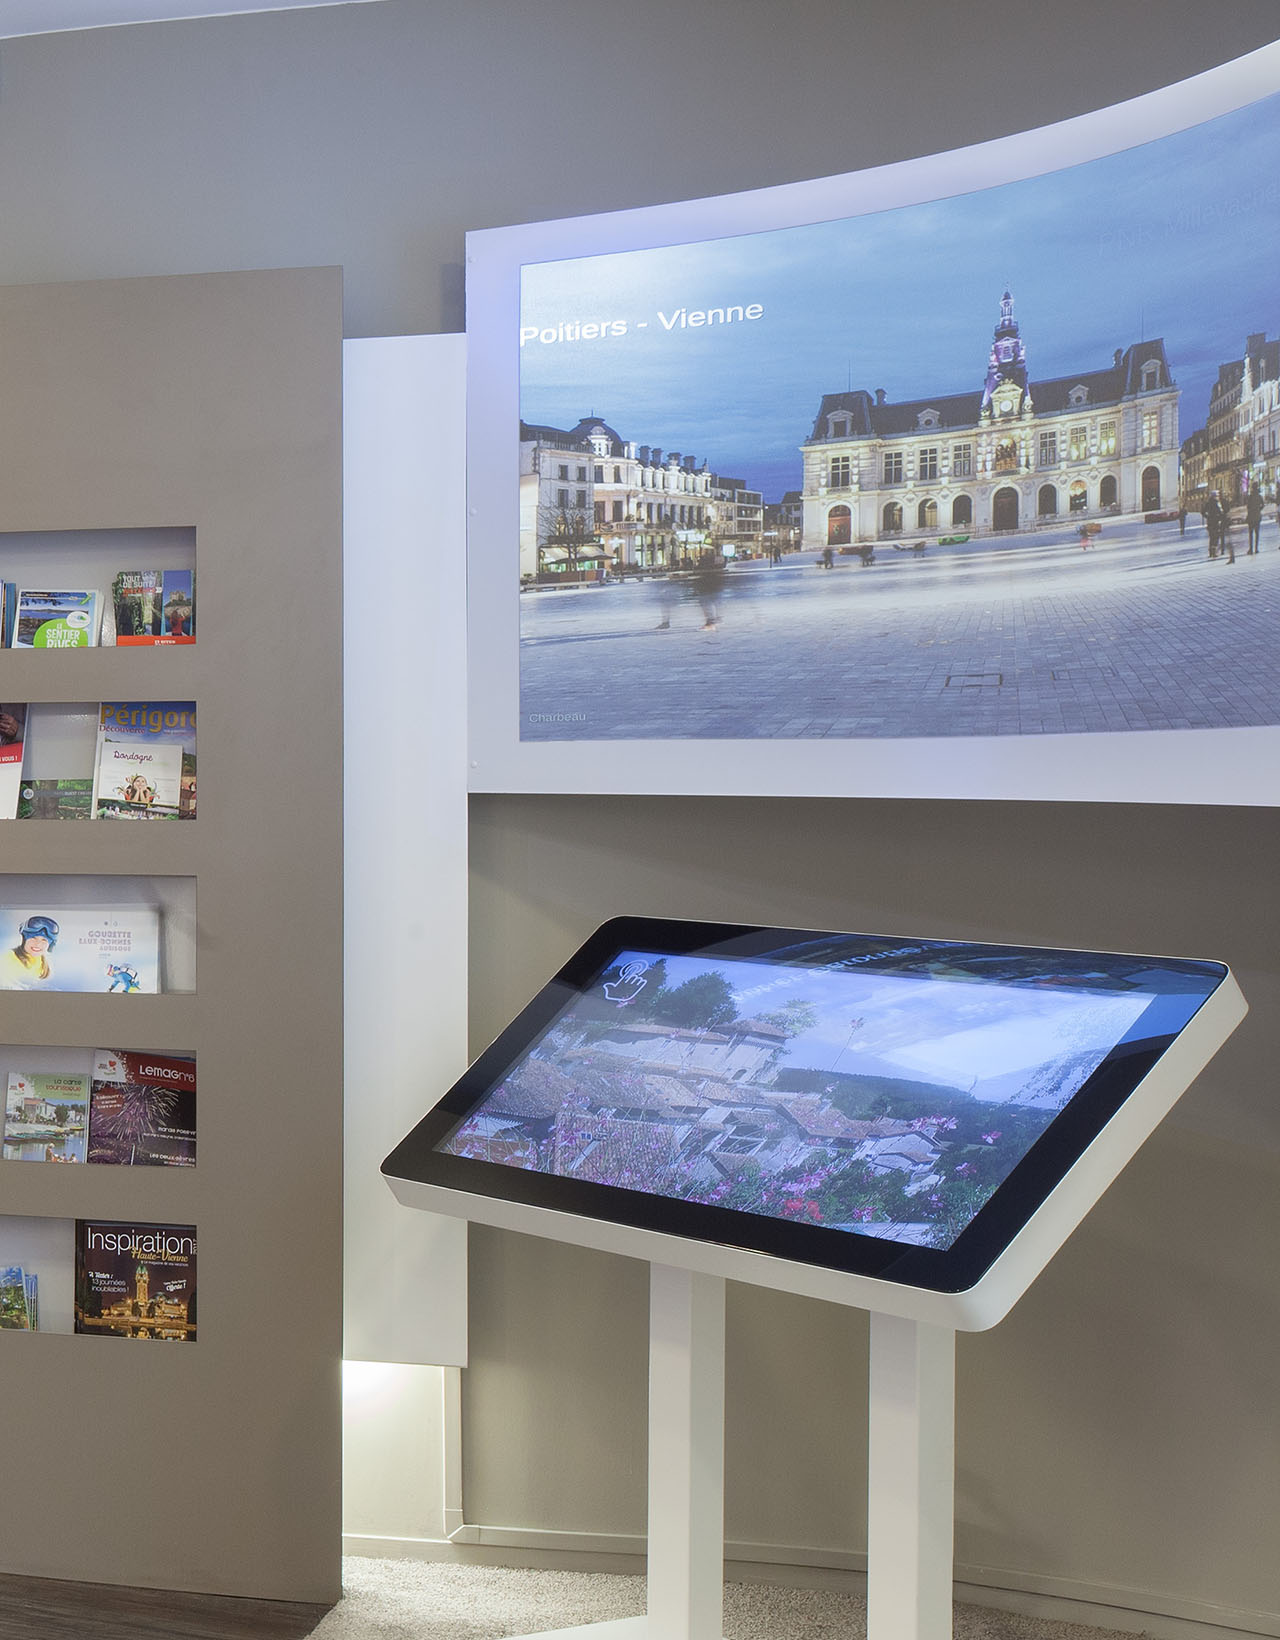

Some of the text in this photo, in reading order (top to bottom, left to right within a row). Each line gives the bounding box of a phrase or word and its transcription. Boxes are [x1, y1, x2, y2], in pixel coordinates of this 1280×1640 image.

[520, 320, 628, 348] Poitiers
[657, 303, 764, 331] Vienne
[45, 629, 80, 640] SENTIER
[99, 724, 145, 735] Découverte
[113, 750, 154, 764] Dordogne
[87, 1226, 193, 1256] Inspiration
[130, 1247, 188, 1263] Haute-Vienne
[99, 1278, 126, 1286] journées
[91, 1285, 127, 1293] inoubliables
